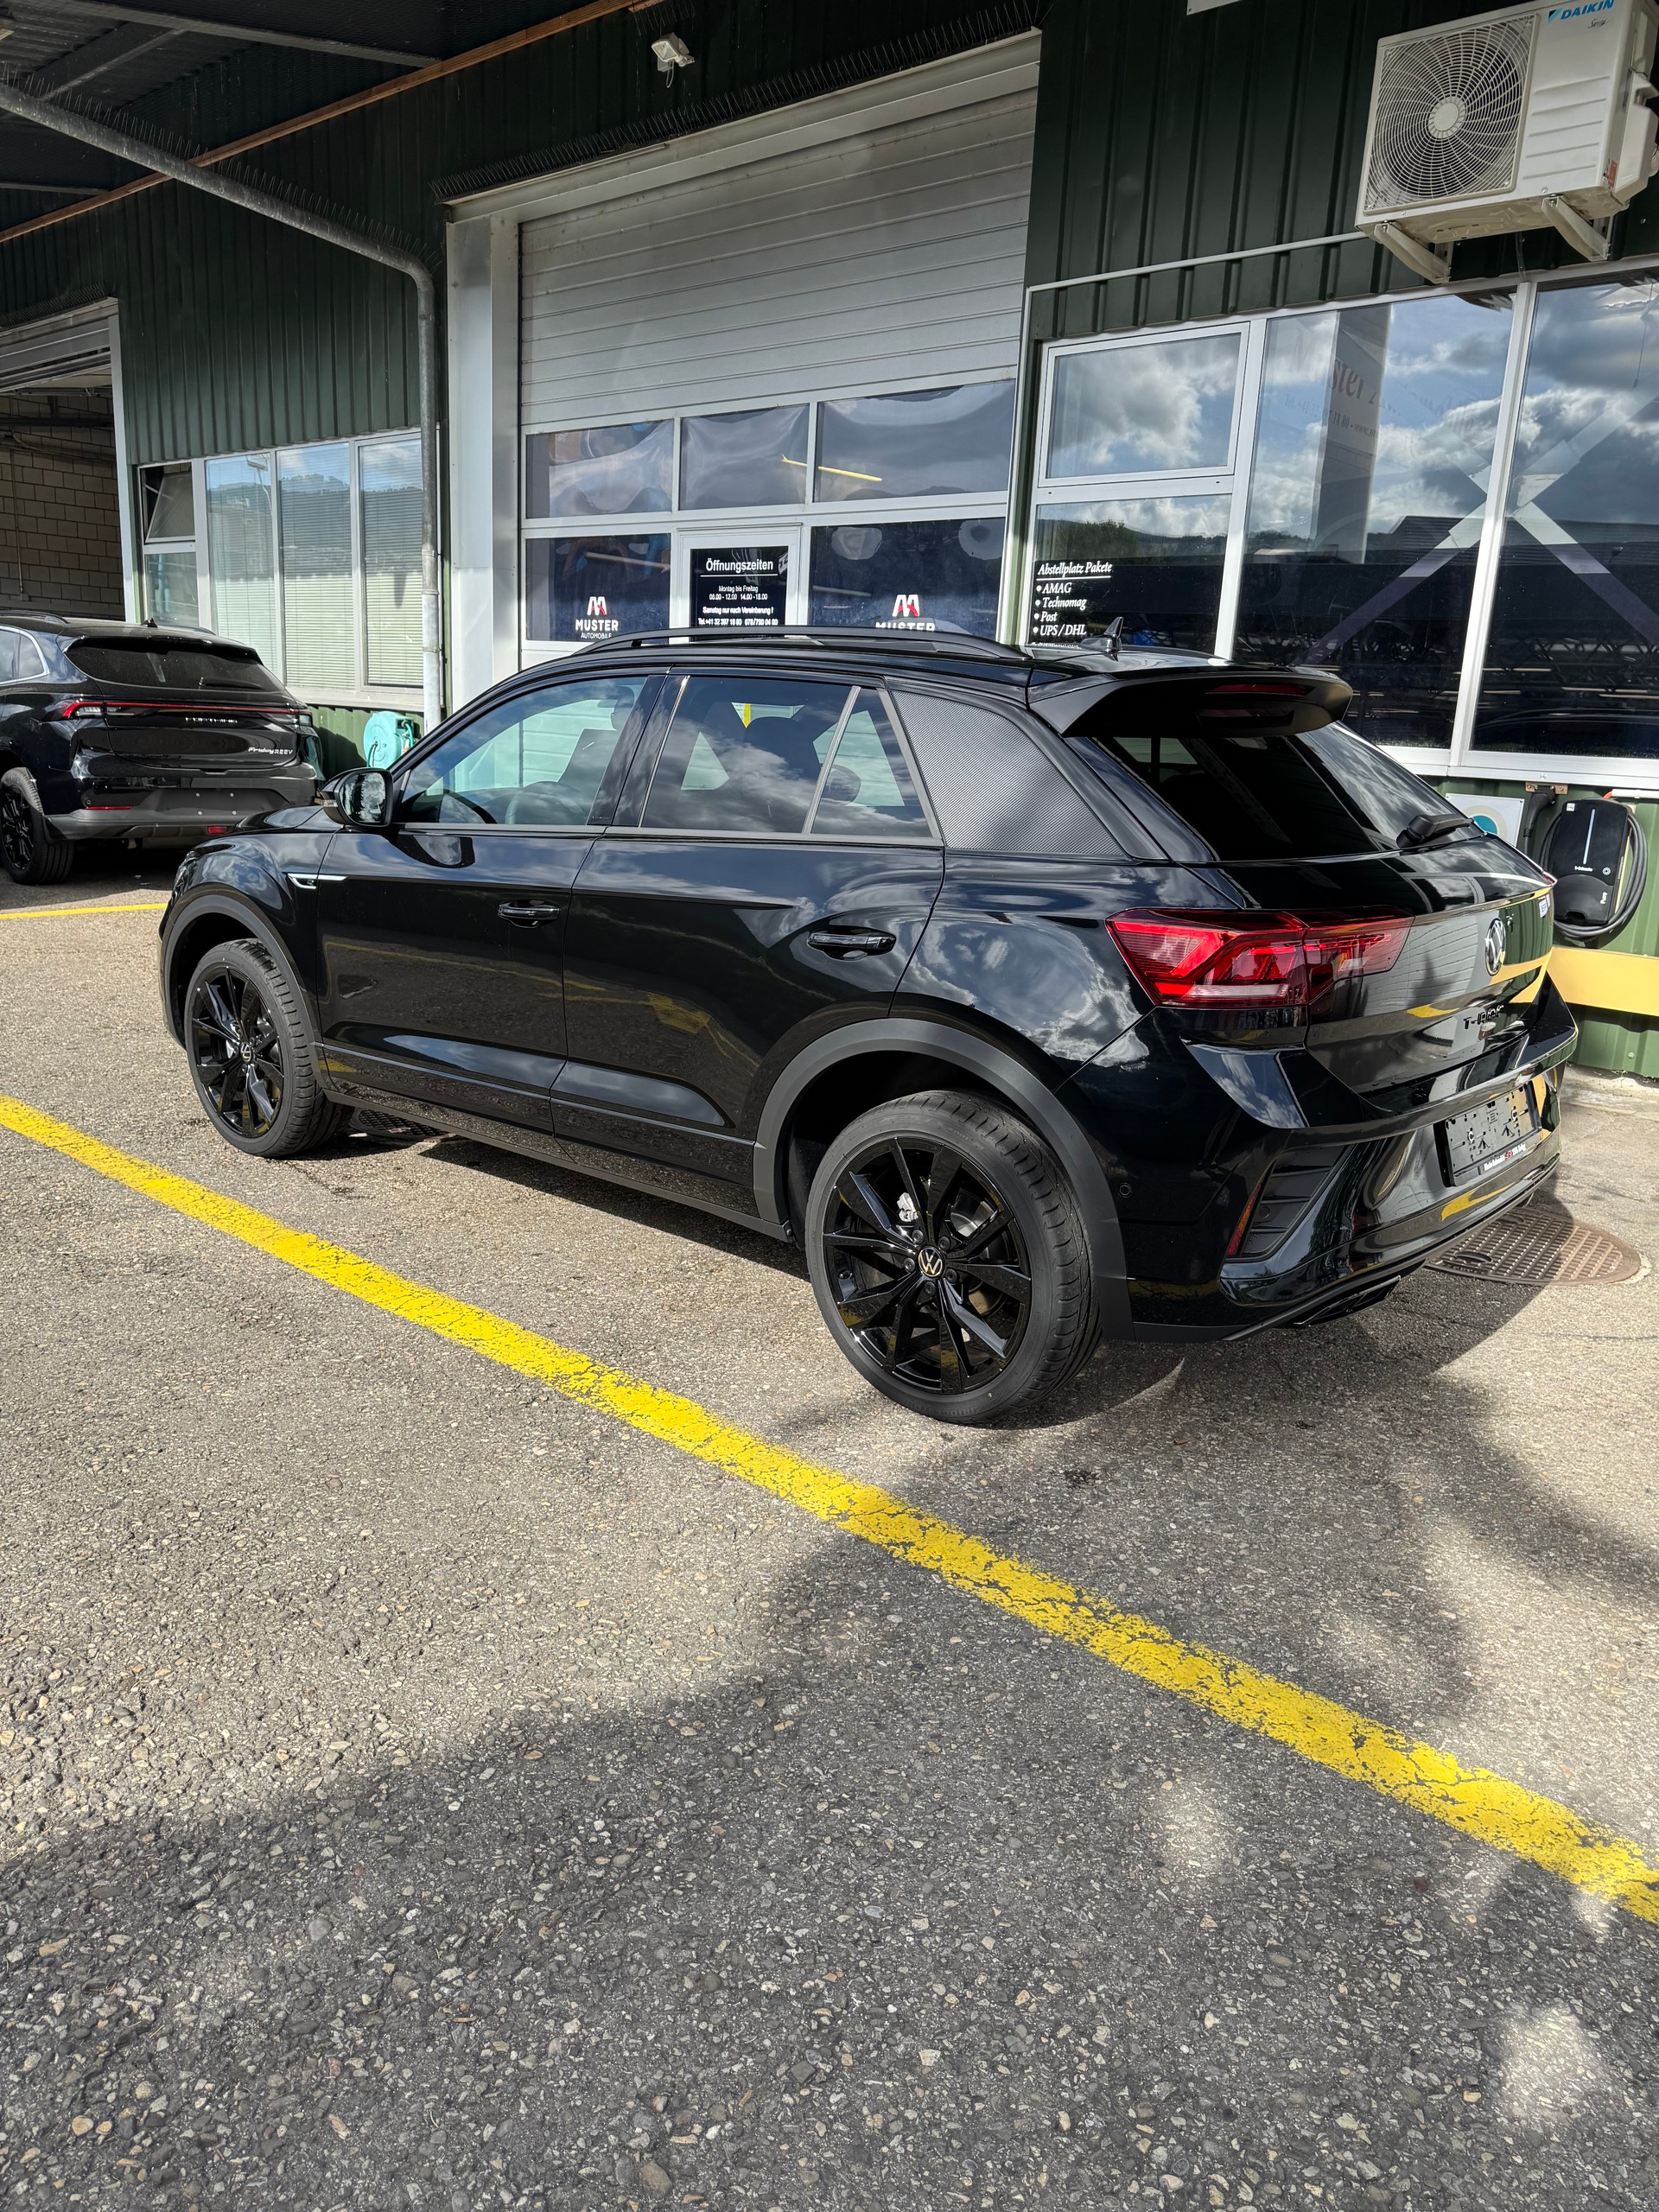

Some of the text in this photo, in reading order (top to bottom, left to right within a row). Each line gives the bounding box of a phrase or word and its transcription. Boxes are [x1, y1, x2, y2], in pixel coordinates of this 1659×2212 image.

[1560, 0, 1615, 20] DAIKIN
[706, 558, 773, 573] Öffnungszeiten
[1038, 560, 1113, 578] Abstellplatz Pakete
[743, 585, 759, 594] Freitag
[1042, 582, 1072, 594] AMAG
[1042, 596, 1087, 611] Technomag
[702, 607, 722, 615] Samstag
[741, 607, 771, 615] Vereinbarung
[1040, 611, 1058, 622] Post
[575, 619, 619, 631] MUSTER
